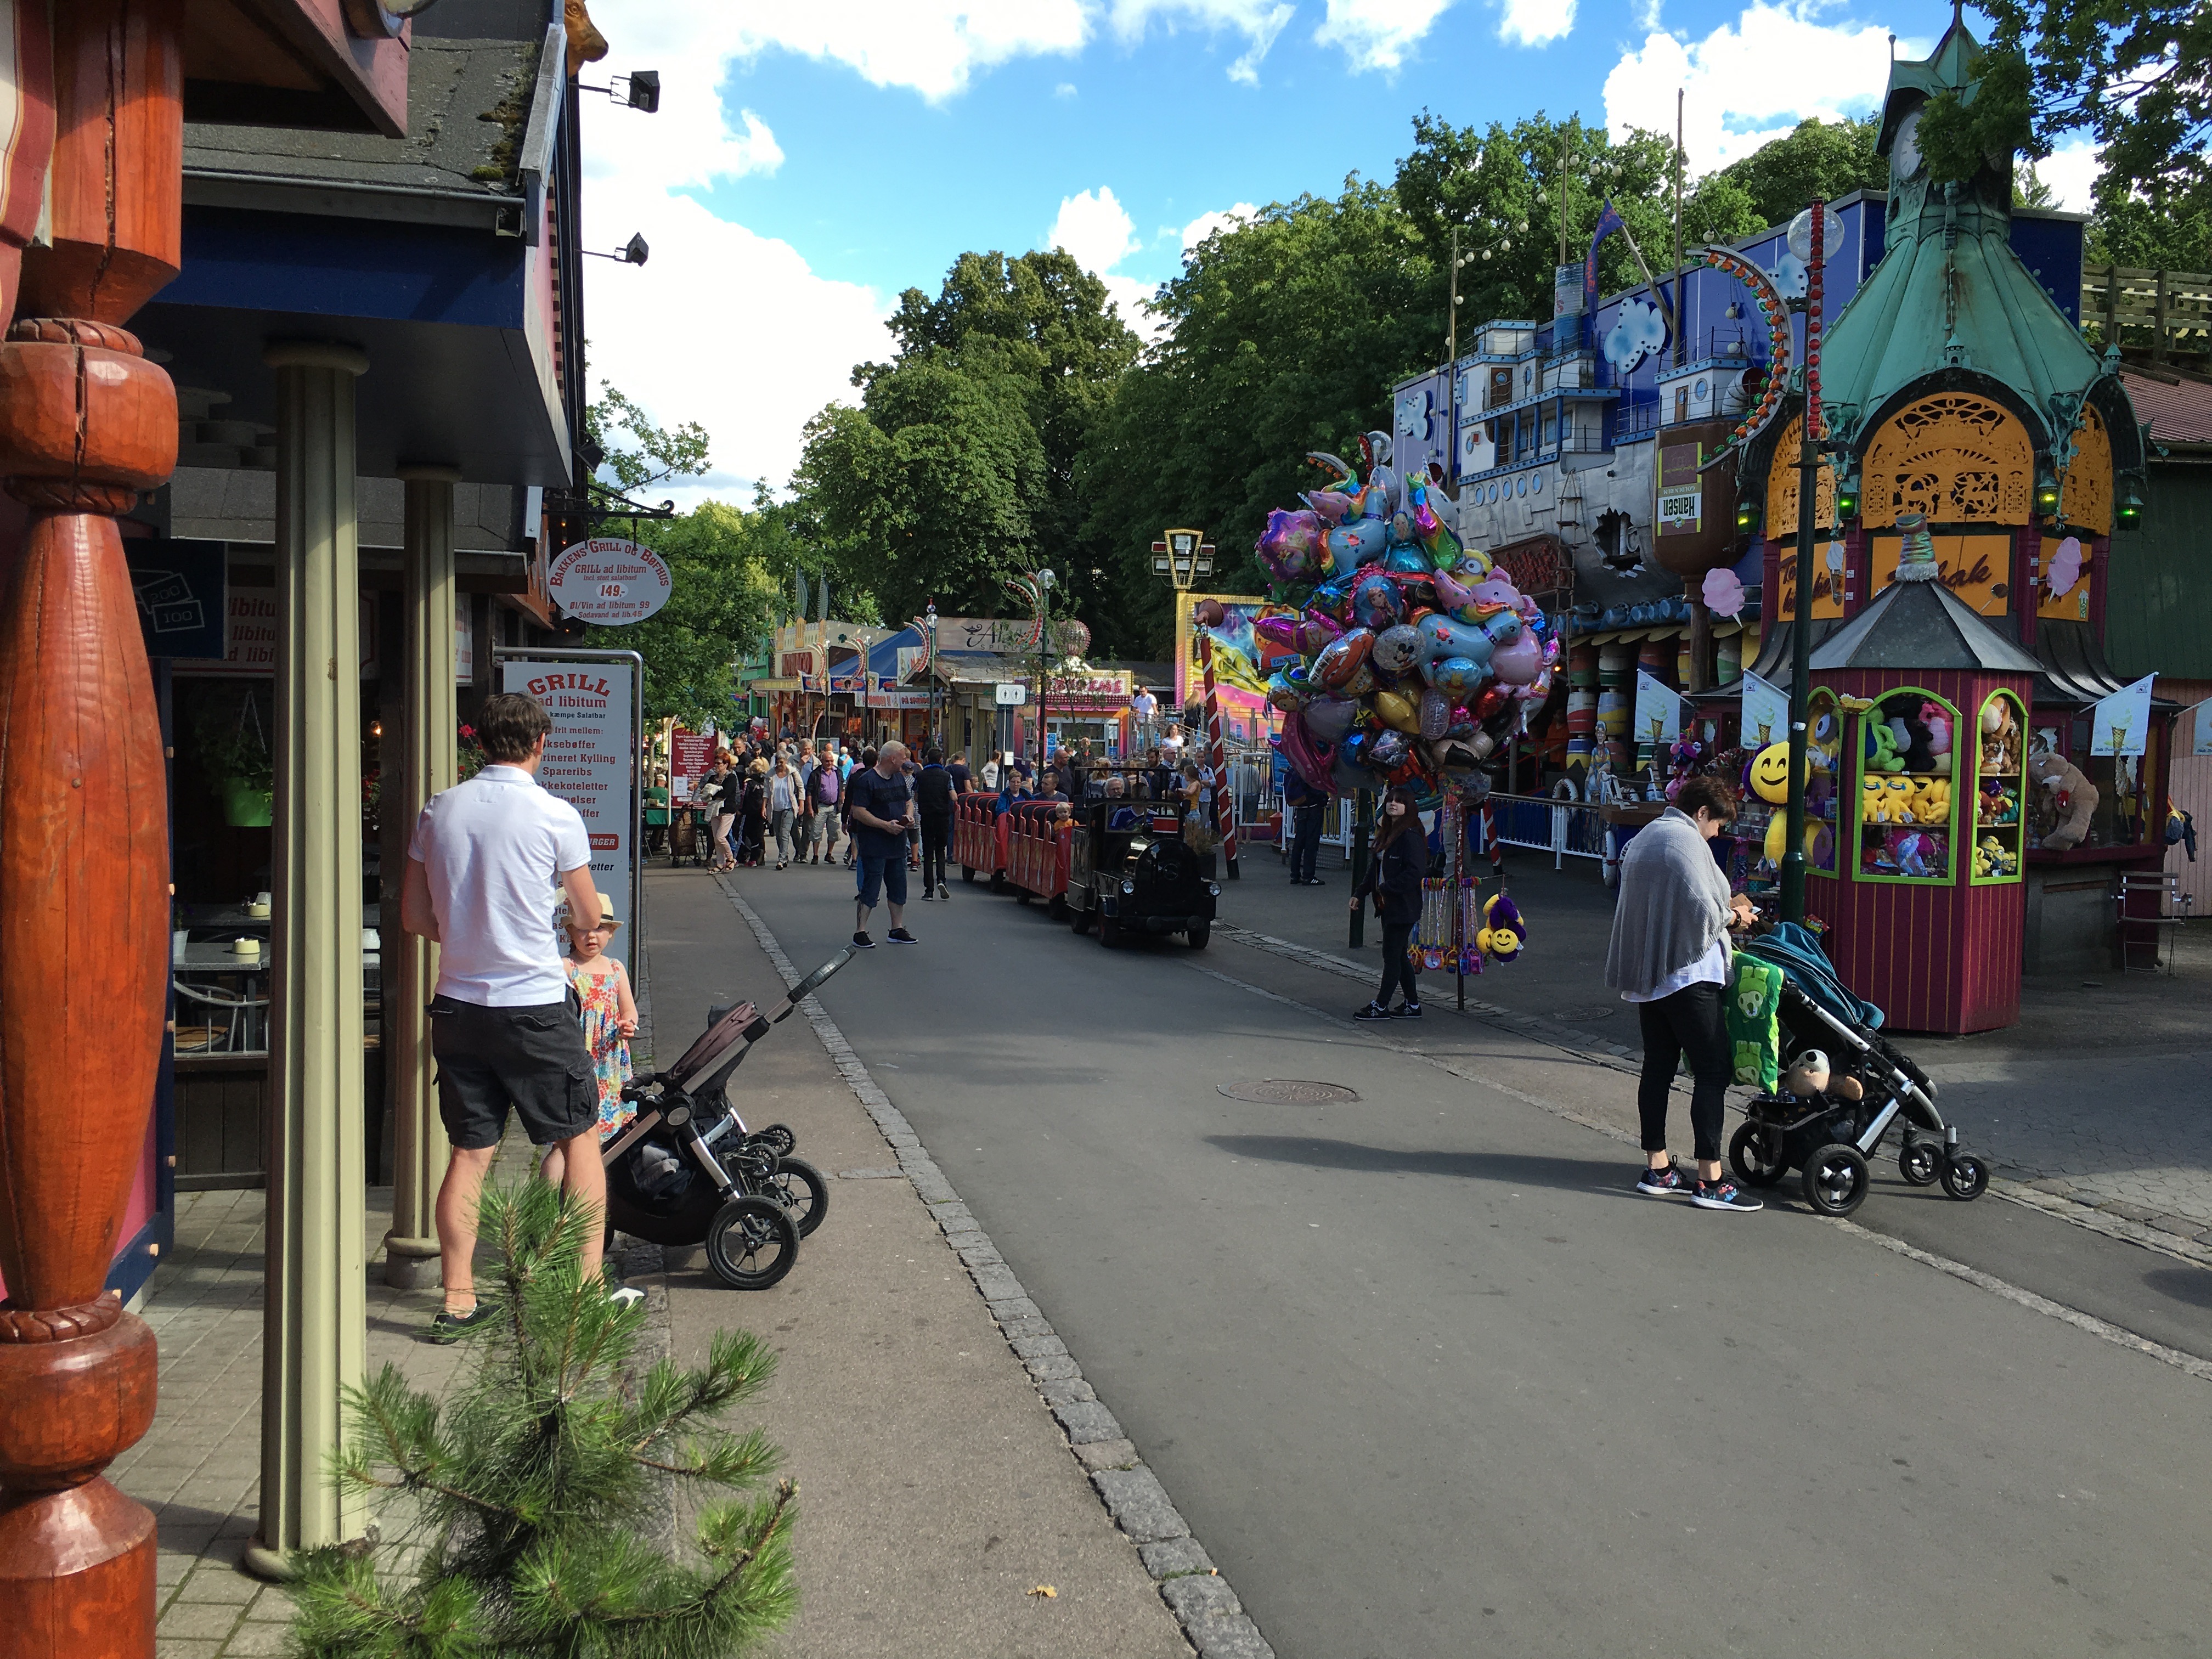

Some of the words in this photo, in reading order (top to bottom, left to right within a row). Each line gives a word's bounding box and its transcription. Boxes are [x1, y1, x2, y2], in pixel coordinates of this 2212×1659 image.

[1675, 485, 1695, 493] GOLDEN
[1663, 496, 1695, 516] Hansen
[550, 548, 587, 587] BAKKENS
[589, 540, 622, 554] GRILL
[640, 549, 669, 586] BØFHUS
[575, 564, 601, 574] GRILL
[603, 564, 614, 573] ad
[617, 564, 647, 573] libitum
[150, 585, 180, 603] 200
[600, 585, 625, 598] 149,-
[228, 597, 275, 617] ibitu
[569, 601, 594, 610] Øl/Vin
[165, 611, 192, 623] 100
[233, 625, 275, 641] libitu
[246, 647, 274, 662] libi
[527, 673, 611, 697] GRILL
[538, 696, 553, 707] ad
[559, 696, 606, 708] libitum
[550, 712, 575, 720] kæmpe
[544, 740, 596, 749] ksebøffer
[540, 753, 577, 763] rineret
[580, 753, 616, 765] Kylling
[543, 766, 592, 777] Spareribs
[537, 781, 608, 791] kkekoteletter
